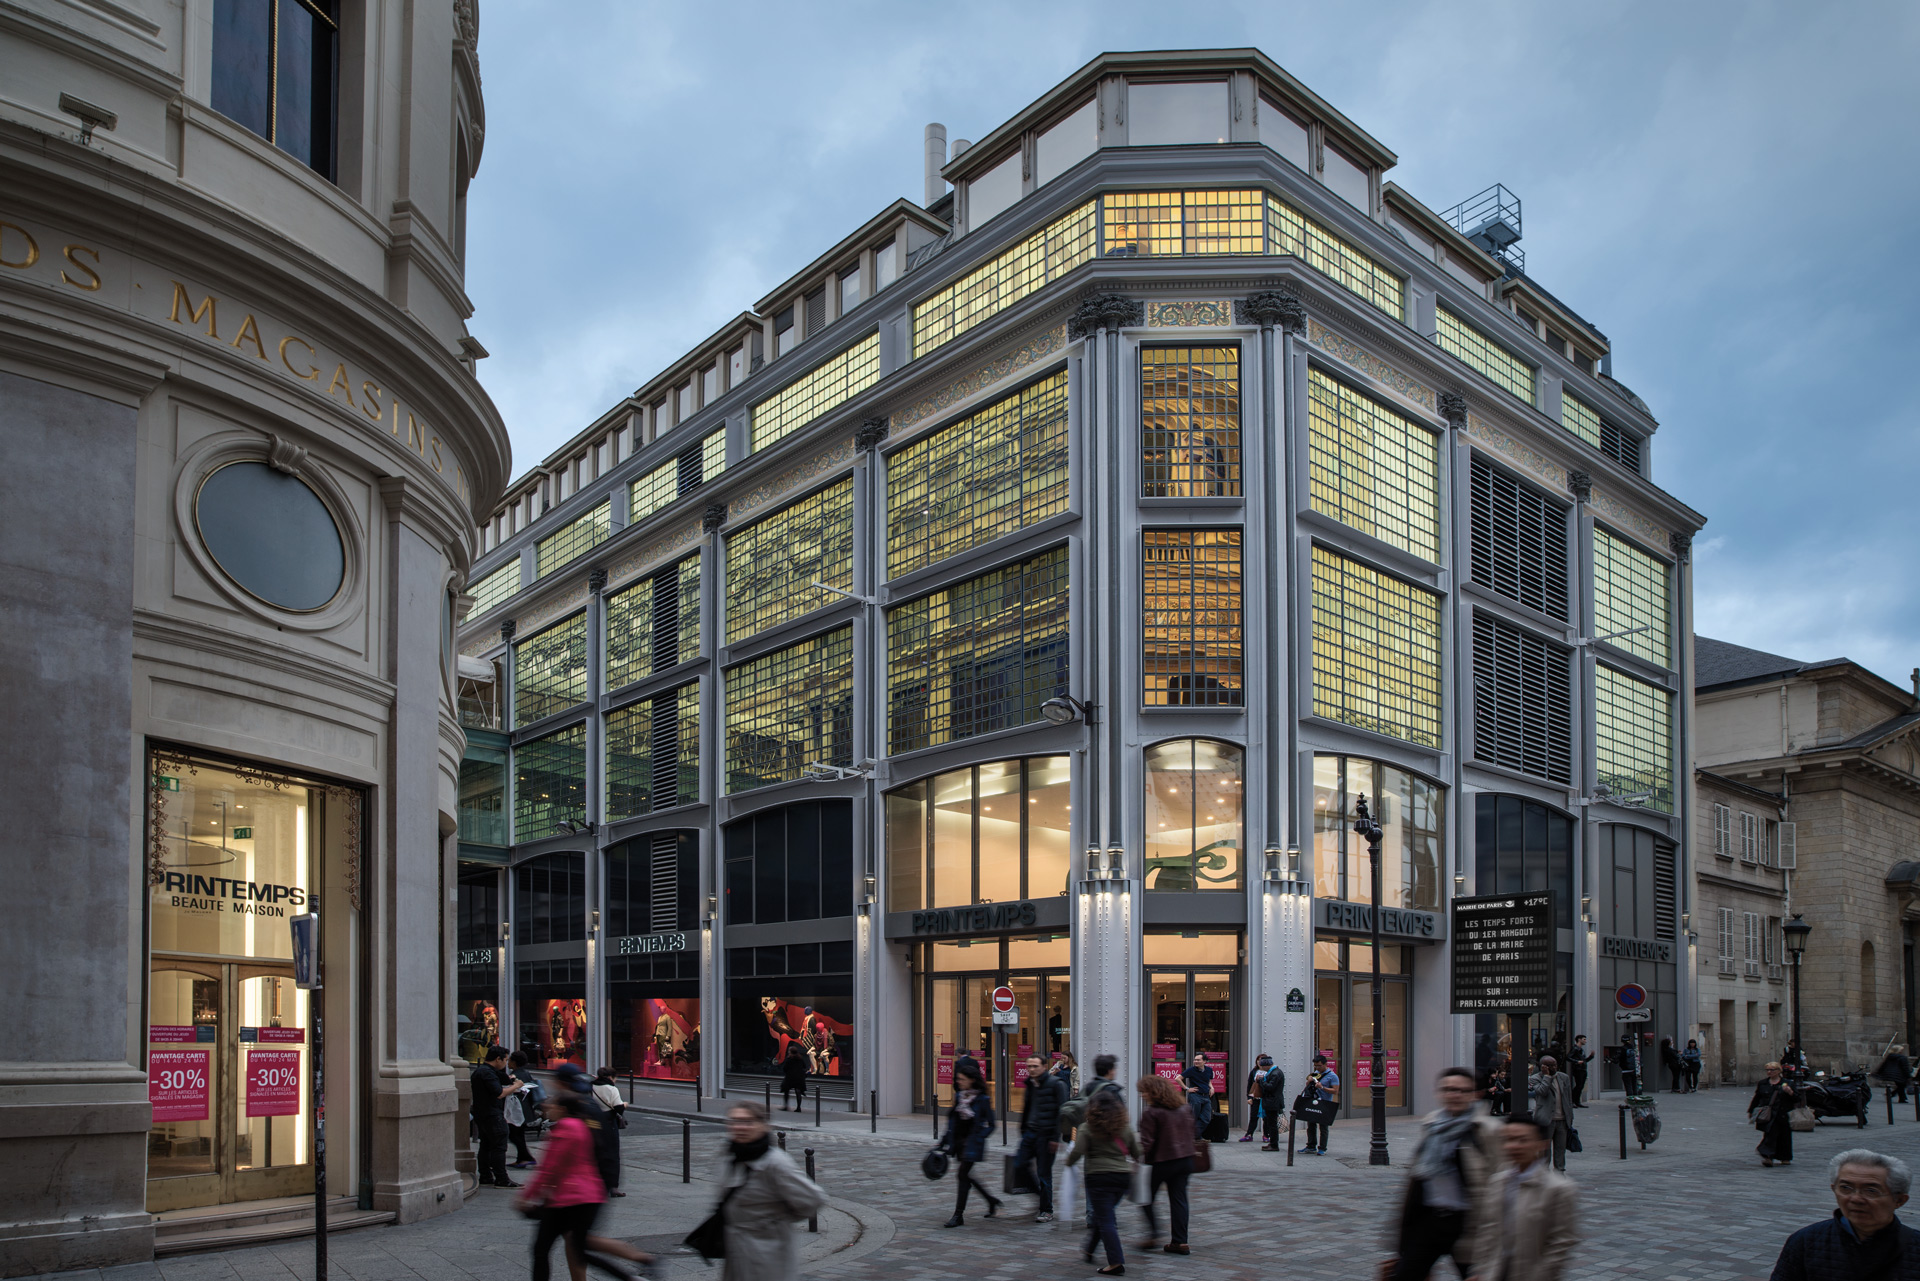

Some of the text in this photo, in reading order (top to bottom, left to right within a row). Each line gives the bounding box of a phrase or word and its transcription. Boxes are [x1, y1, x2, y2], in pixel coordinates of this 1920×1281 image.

[166, 279, 443, 473] MAGASINS
[171, 895, 284, 917] BEAUTE MAISON
[912, 902, 1036, 933] PRINTEMPS
[1465, 916, 1534, 928] LES TEMPS FORTS
[1469, 928, 1534, 939] DU 1ER HANGOUT
[618, 933, 685, 954] PRINTEMPS
[1473, 940, 1524, 950] DE LA MAIRE
[1604, 936, 1670, 961] PRINTEMPS
[1482, 952, 1520, 961] DE PARIS
[1482, 975, 1520, 984] EN VIDEO
[1486, 988, 1501, 996] SUR
[1459, 998, 1538, 1008] PARIS.FR/HANGOUTS
[938, 1065, 952, 1074] -30%
[1357, 1067, 1371, 1076] -30%
[1386, 1066, 1399, 1075] -30%
[151, 1069, 205, 1089] -30%
[250, 1067, 297, 1087] -30%
